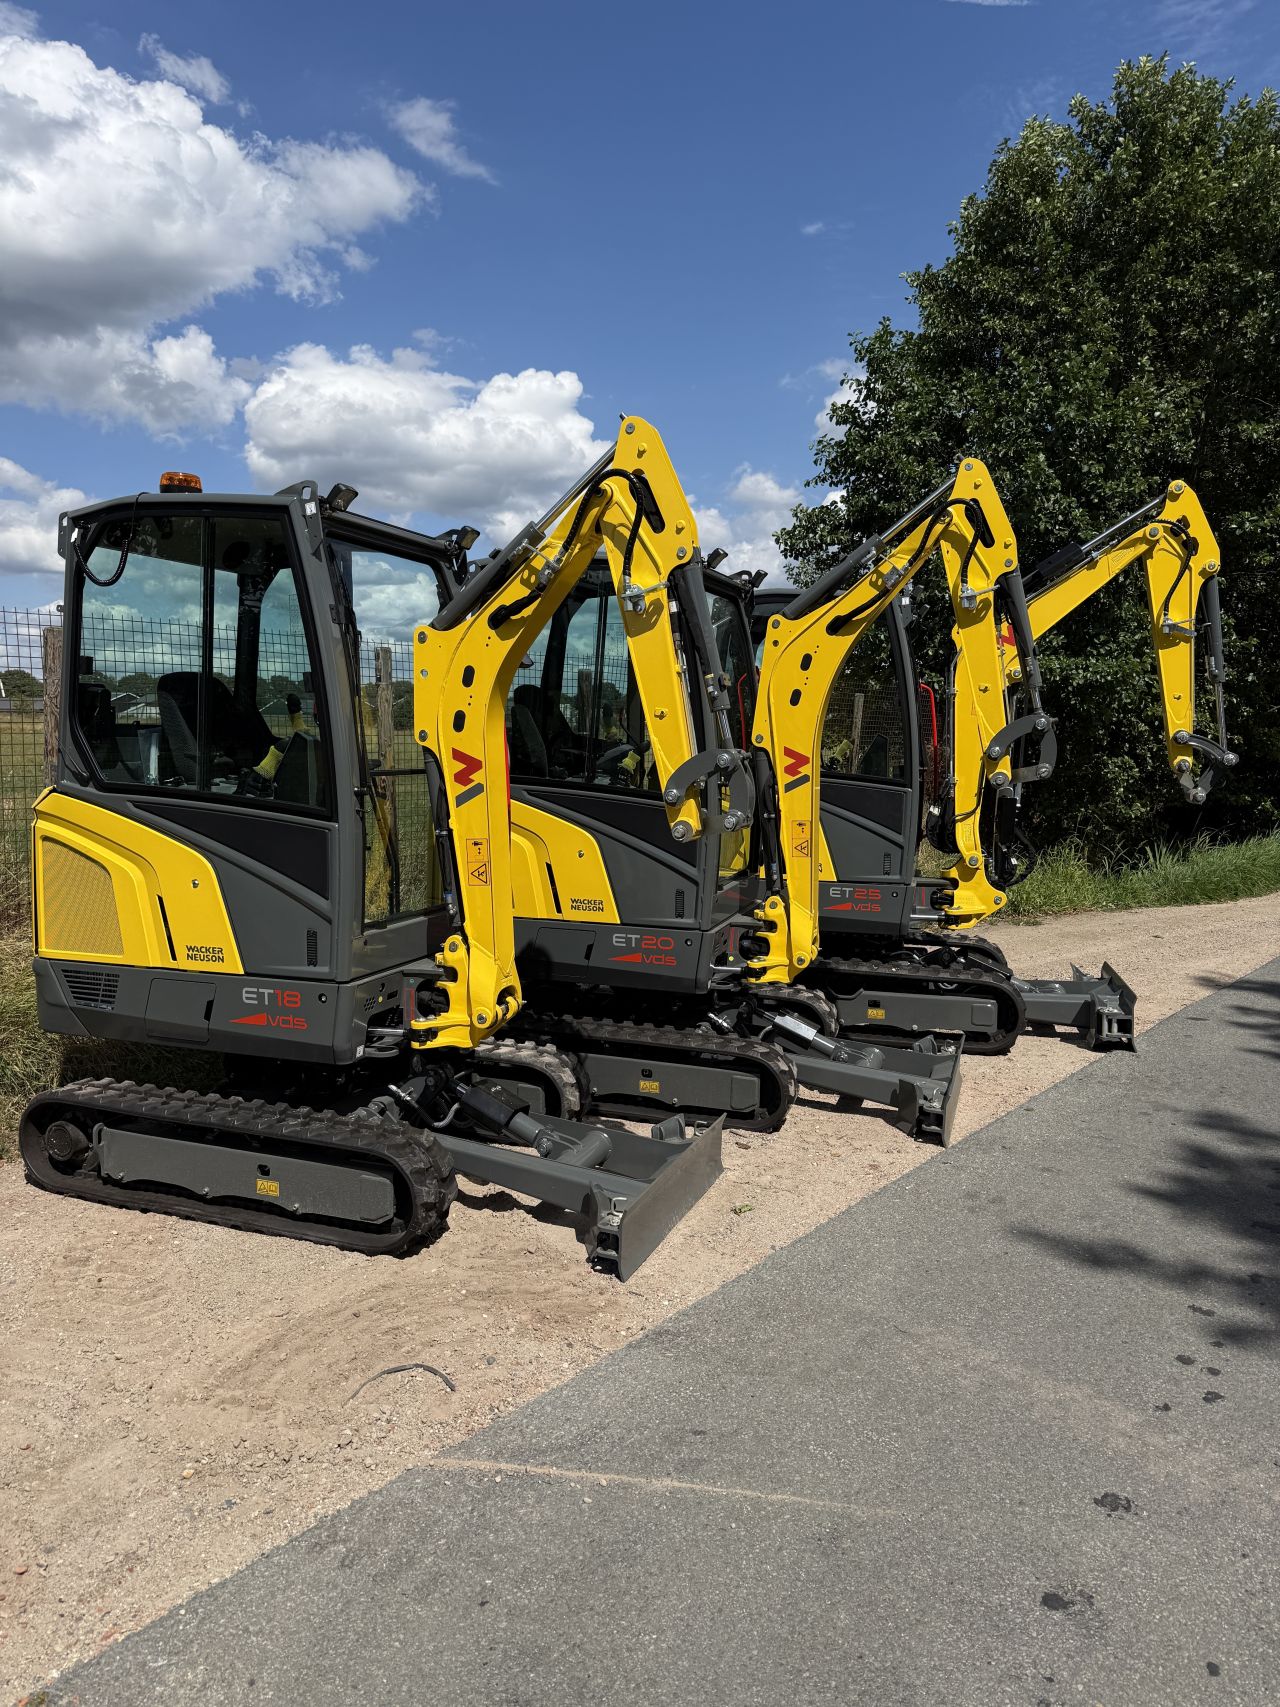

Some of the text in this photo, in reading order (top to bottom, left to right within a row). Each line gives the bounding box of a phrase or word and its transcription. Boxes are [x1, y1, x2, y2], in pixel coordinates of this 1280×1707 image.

[829, 887, 881, 900] ET25
[570, 898, 604, 907] WACKER
[571, 904, 604, 912] NEUSON
[851, 903, 881, 912] vds
[612, 933, 675, 951] ET20
[185, 944, 224, 955] WACKER
[186, 952, 225, 964] NEUSON
[642, 953, 677, 966] vds
[242, 987, 302, 1008] ET18
[266, 1014, 308, 1030] vds
